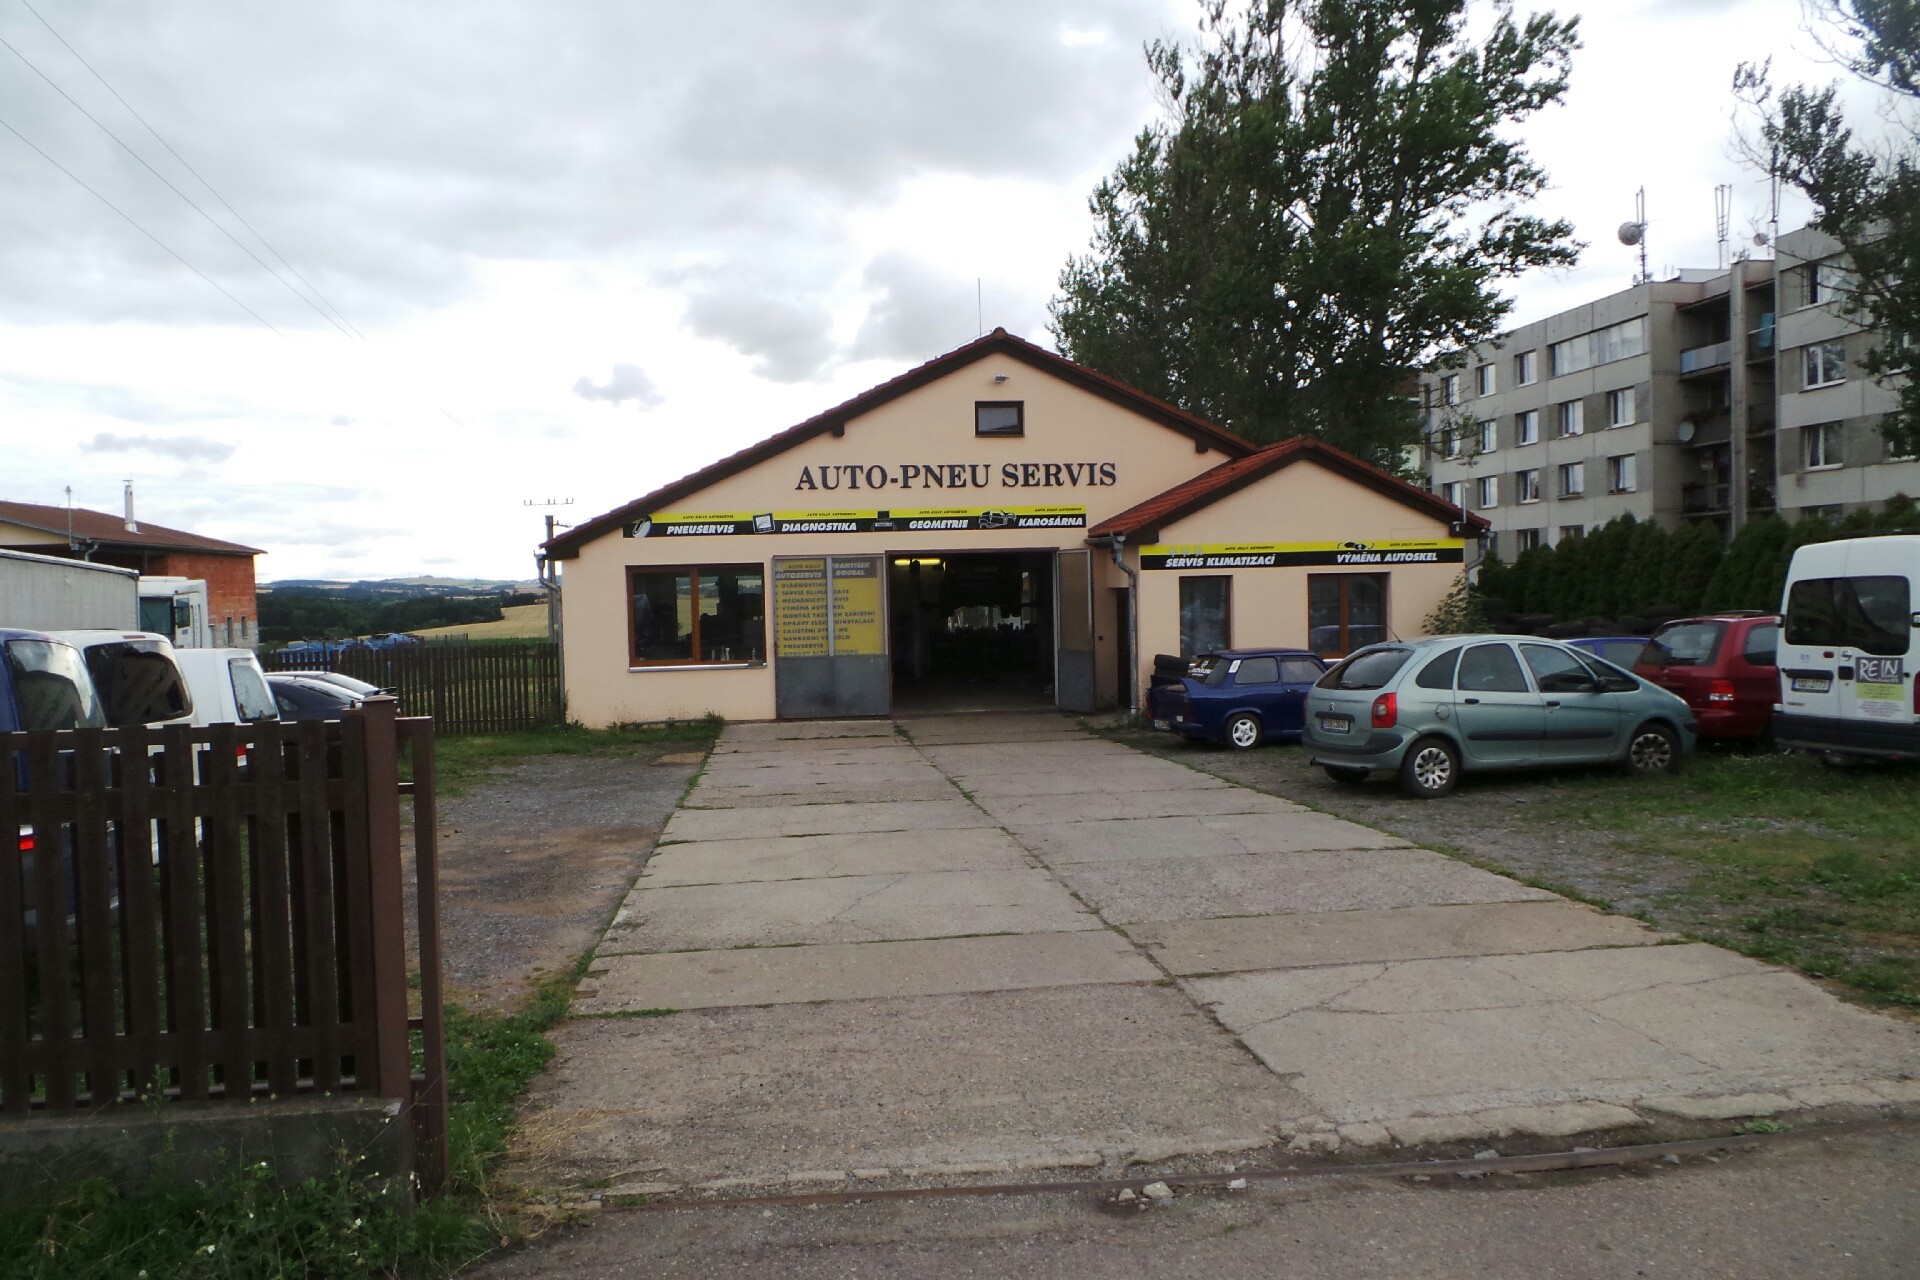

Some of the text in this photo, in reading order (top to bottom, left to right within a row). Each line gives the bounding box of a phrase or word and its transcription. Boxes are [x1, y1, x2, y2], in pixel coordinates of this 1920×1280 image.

[795, 462, 1117, 491] AUTO-PNEU SERVIS
[909, 519, 969, 529] GEOMETRIE
[1018, 513, 1083, 527] KAROSÁRNA
[667, 524, 735, 535] PNEUSERVIS
[781, 522, 857, 532] DIAGNOSTIKA
[1165, 553, 1276, 567] SERVIS KLIMATIZACÍ
[1337, 552, 1438, 563] VÝMĚNA AUTOSKEL
[775, 571, 823, 579] AUTOSERVIS
